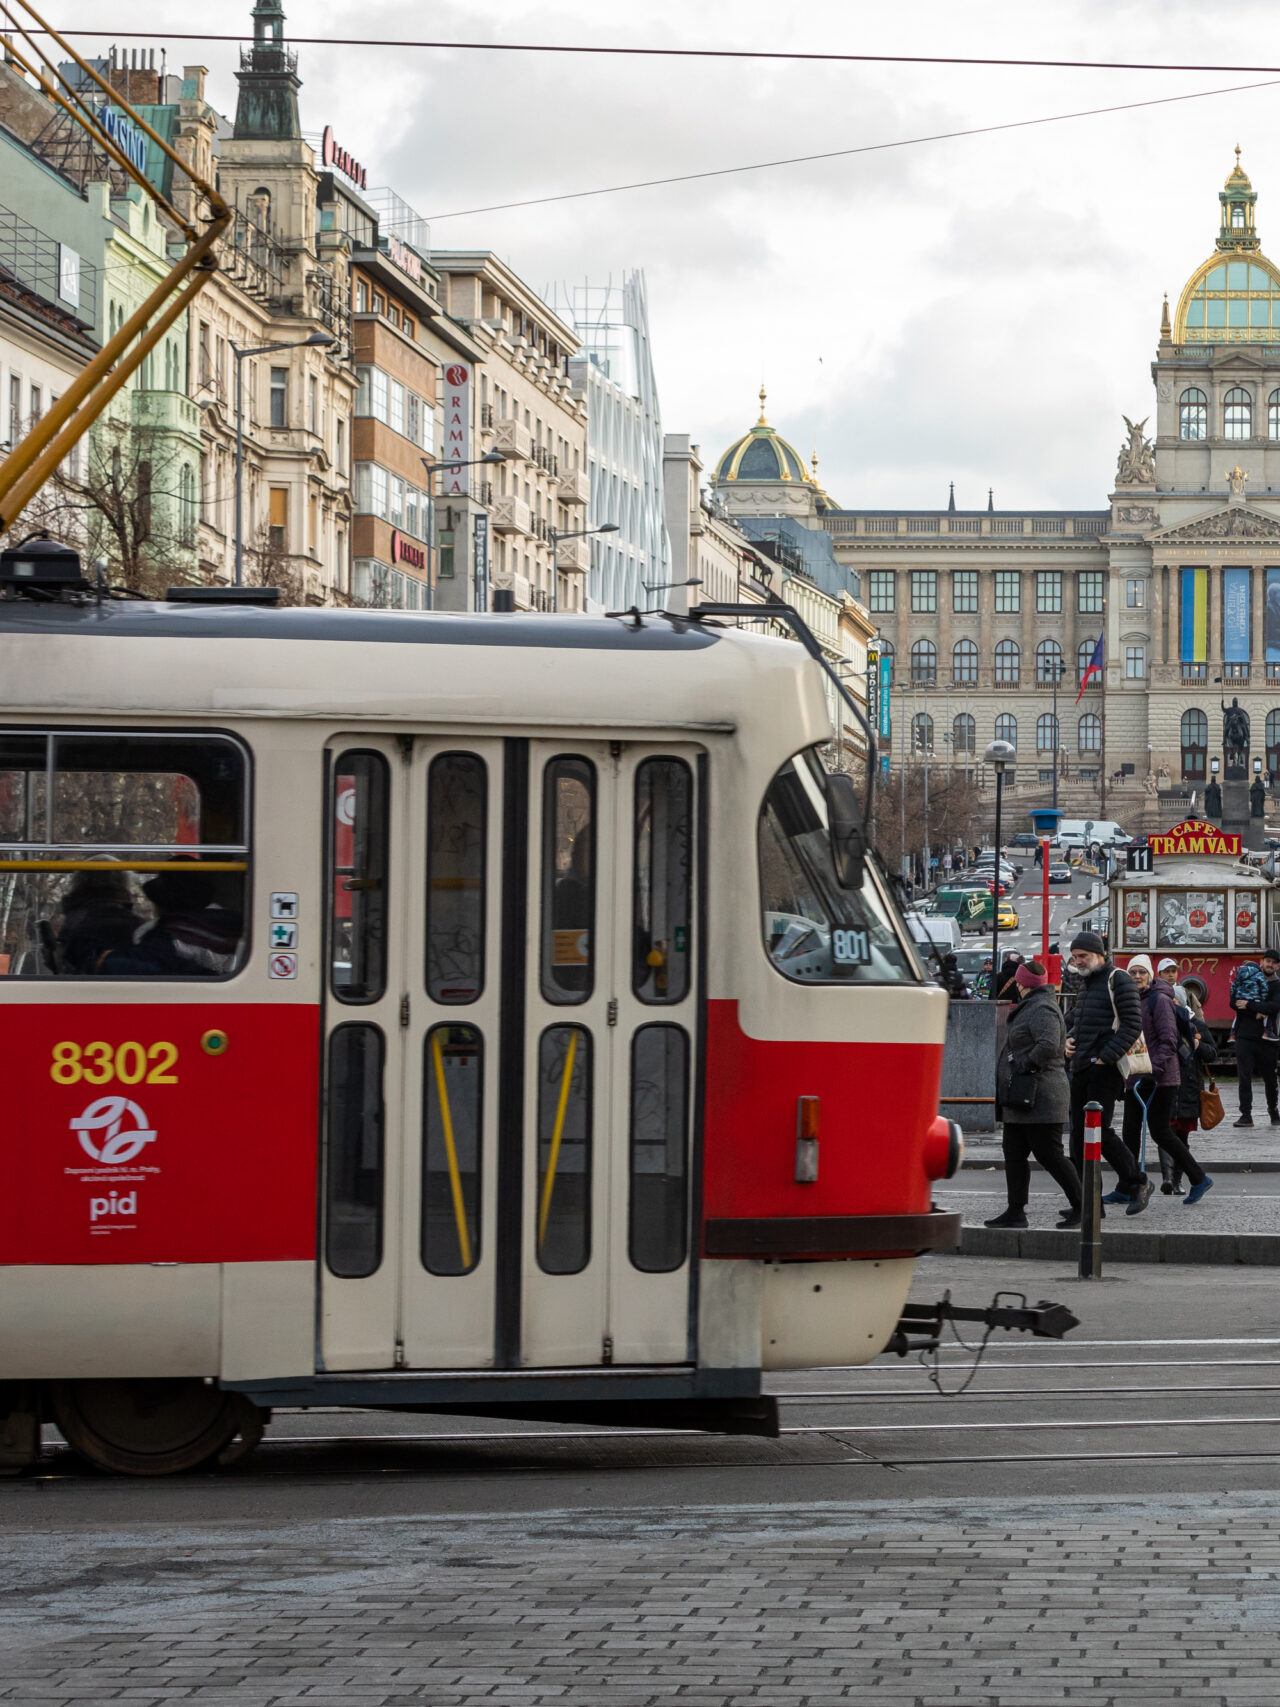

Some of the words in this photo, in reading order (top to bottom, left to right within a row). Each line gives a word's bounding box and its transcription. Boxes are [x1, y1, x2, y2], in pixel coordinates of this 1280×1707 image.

[104, 107, 146, 174] CASINO
[332, 140, 367, 191] RAMADA
[449, 396, 463, 492] RAMADA
[1172, 821, 1217, 837] CAFE
[1132, 849, 1148, 870] 11
[1150, 837, 1240, 855] TRAMVAJ
[833, 930, 868, 960] 801
[49, 1041, 179, 1085] 8302
[90, 1190, 137, 1221] pid
